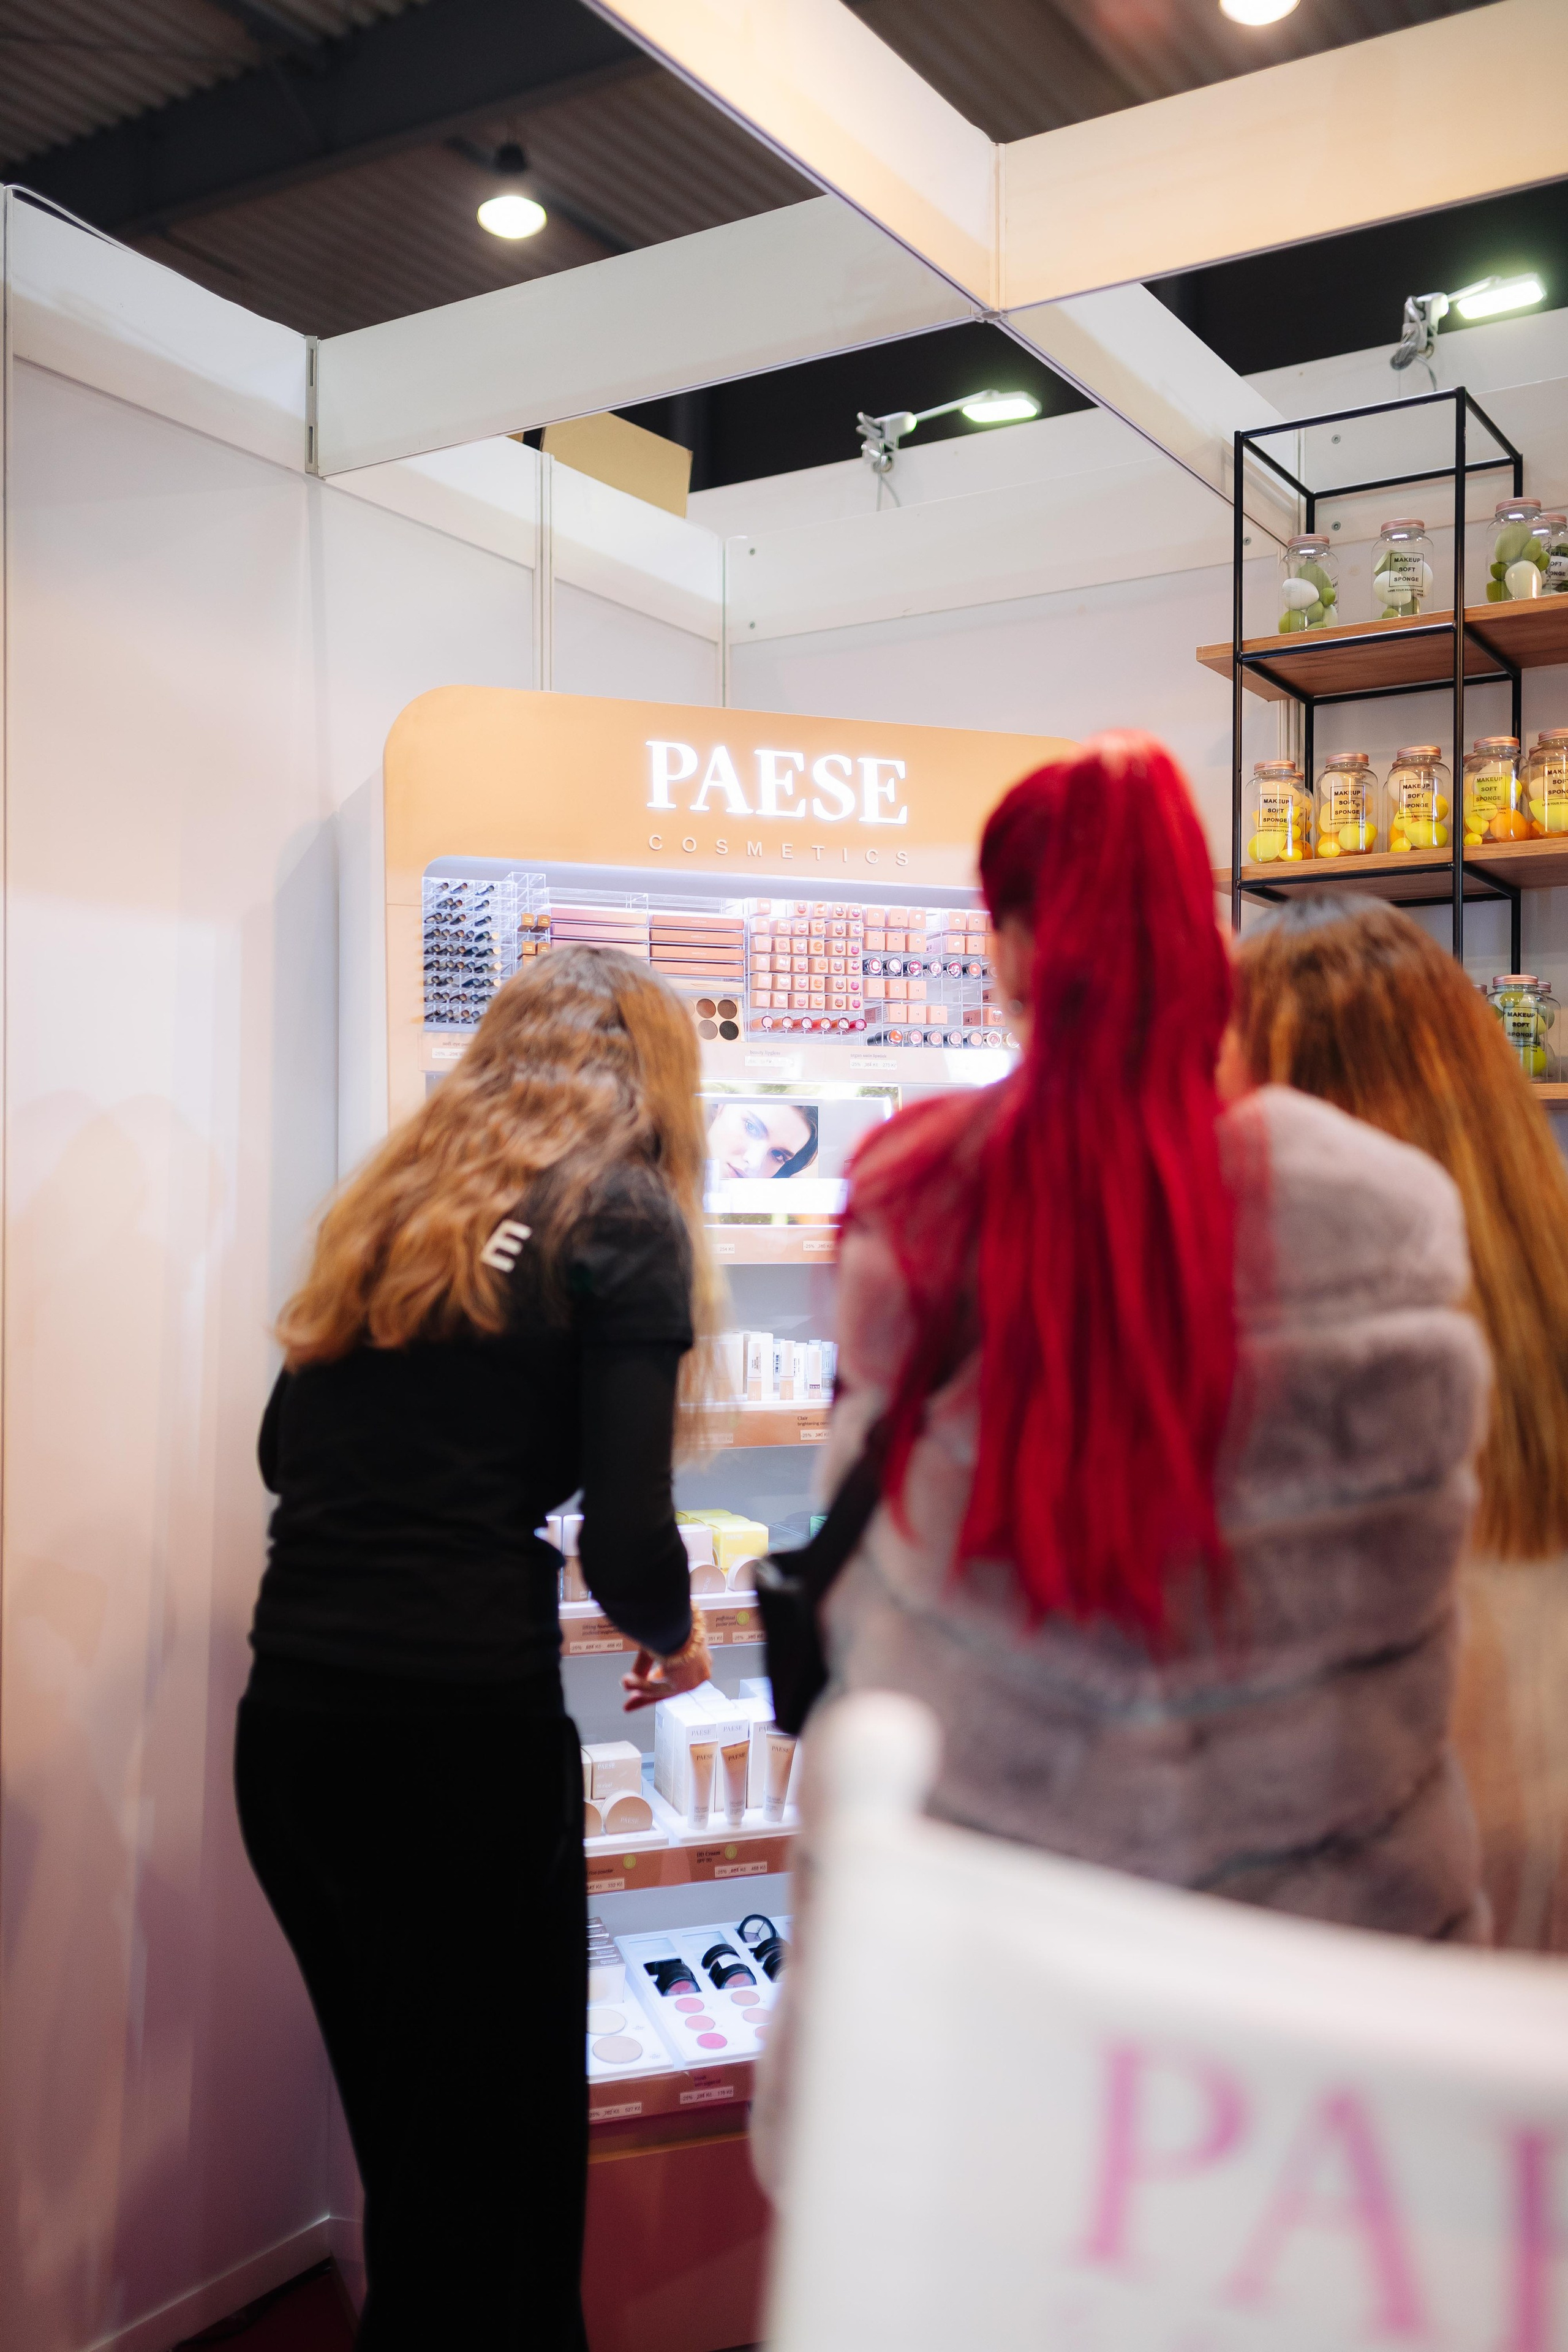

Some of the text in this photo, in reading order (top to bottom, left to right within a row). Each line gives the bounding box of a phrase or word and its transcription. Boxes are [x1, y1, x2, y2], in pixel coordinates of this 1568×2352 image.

[646, 740, 908, 824] PAESE
[649, 834, 909, 866] COSMETICS
[728, 1752, 746, 1762] PAESE
